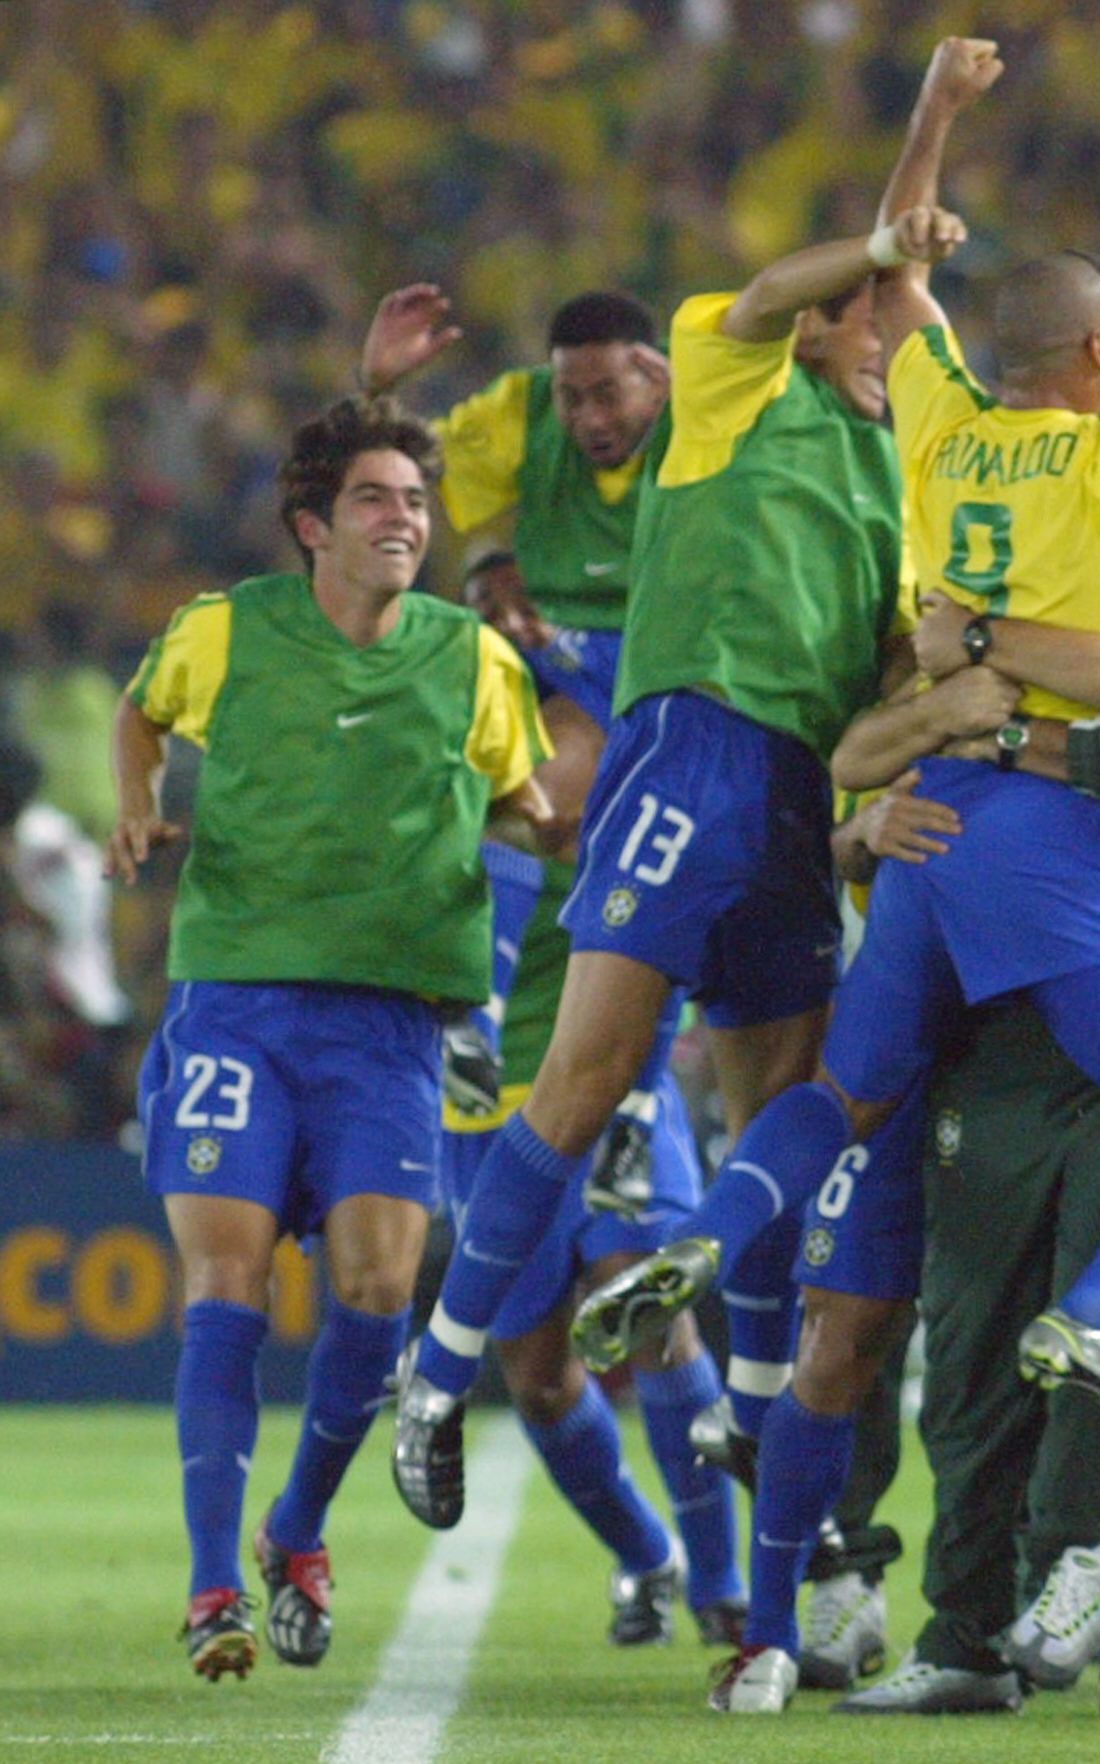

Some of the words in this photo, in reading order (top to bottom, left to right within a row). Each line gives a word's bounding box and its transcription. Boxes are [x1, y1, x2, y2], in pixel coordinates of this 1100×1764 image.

[618, 792, 694, 886] 13
[175, 1054, 253, 1130] 23
[817, 1143, 869, 1219] 6
